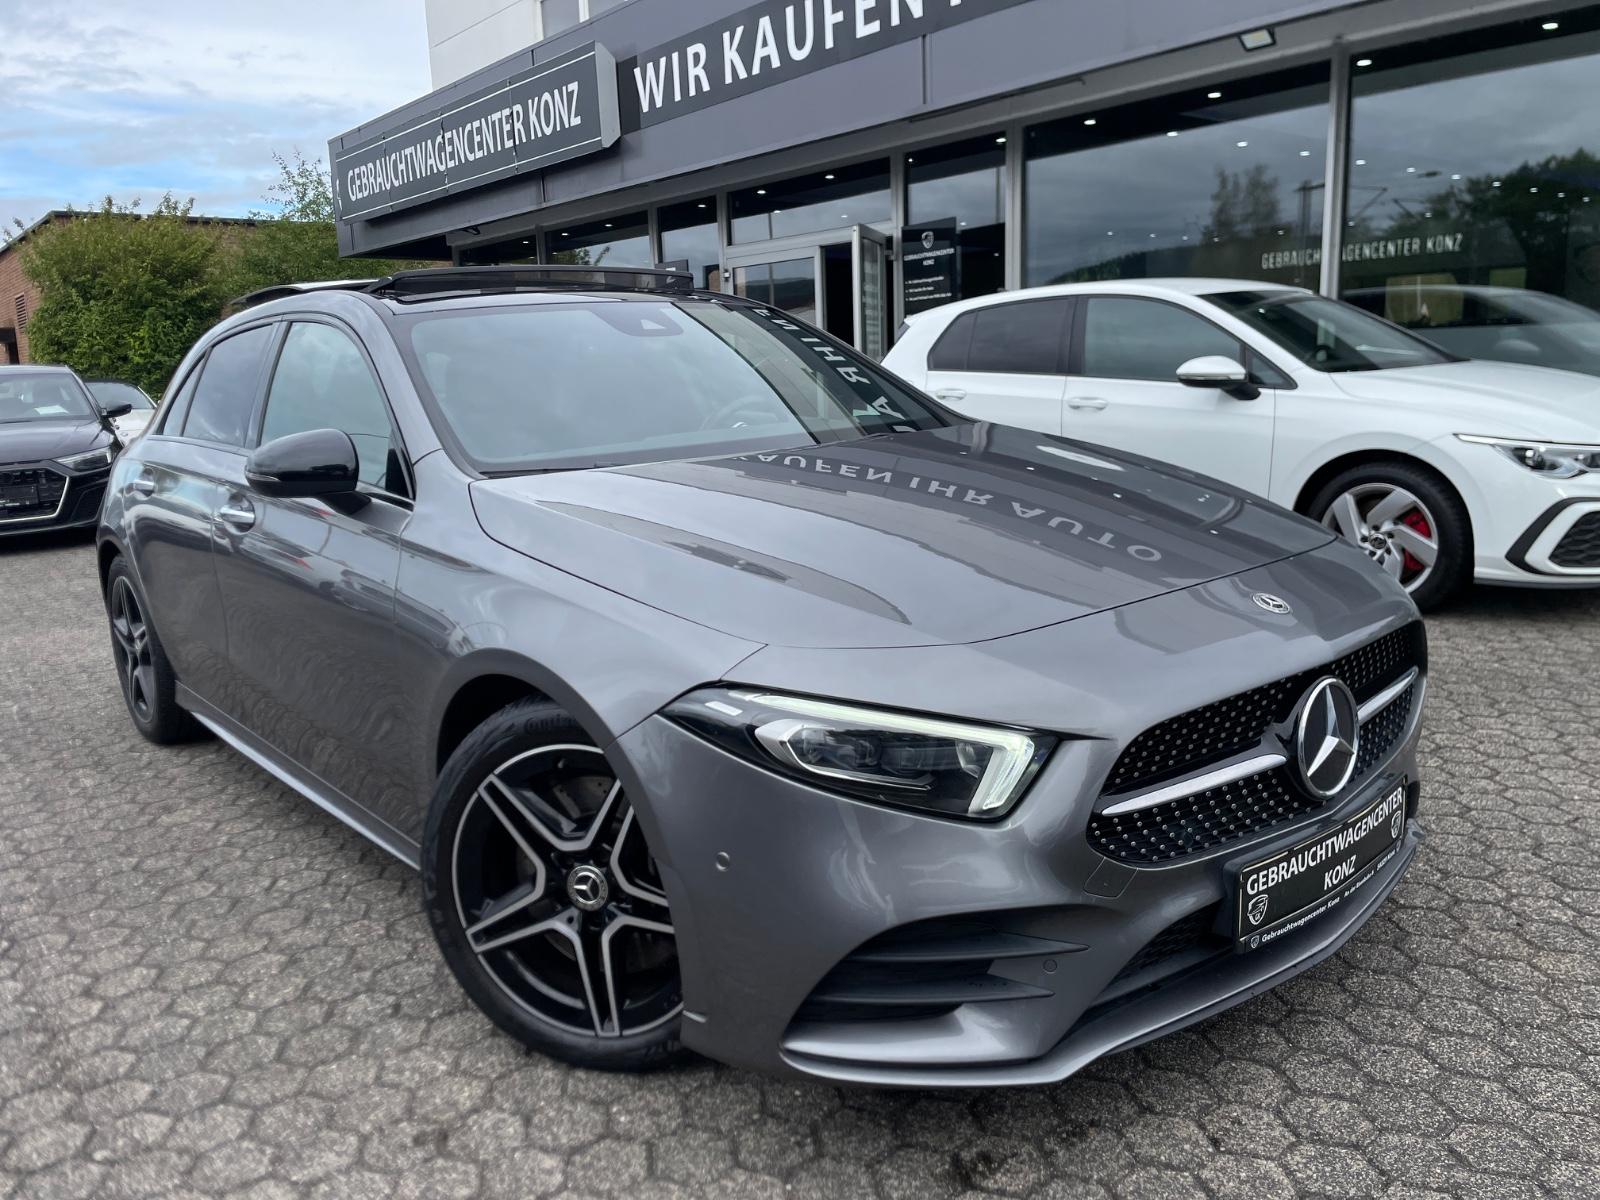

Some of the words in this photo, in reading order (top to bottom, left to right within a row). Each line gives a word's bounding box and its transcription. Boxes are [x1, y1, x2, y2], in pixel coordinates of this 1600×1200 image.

[634, 43, 710, 113] WIR
[347, 103, 527, 202] GEBRAUCHTWAGENCENTER
[528, 80, 582, 140] KONZ
[1261, 238, 1421, 270] GEBRAUCHAGENCENTER
[1426, 233, 1463, 251] KONZ
[1247, 786, 1402, 895] GEBRAUCHTWAGENCENTER
[1324, 854, 1357, 890] KONZ
